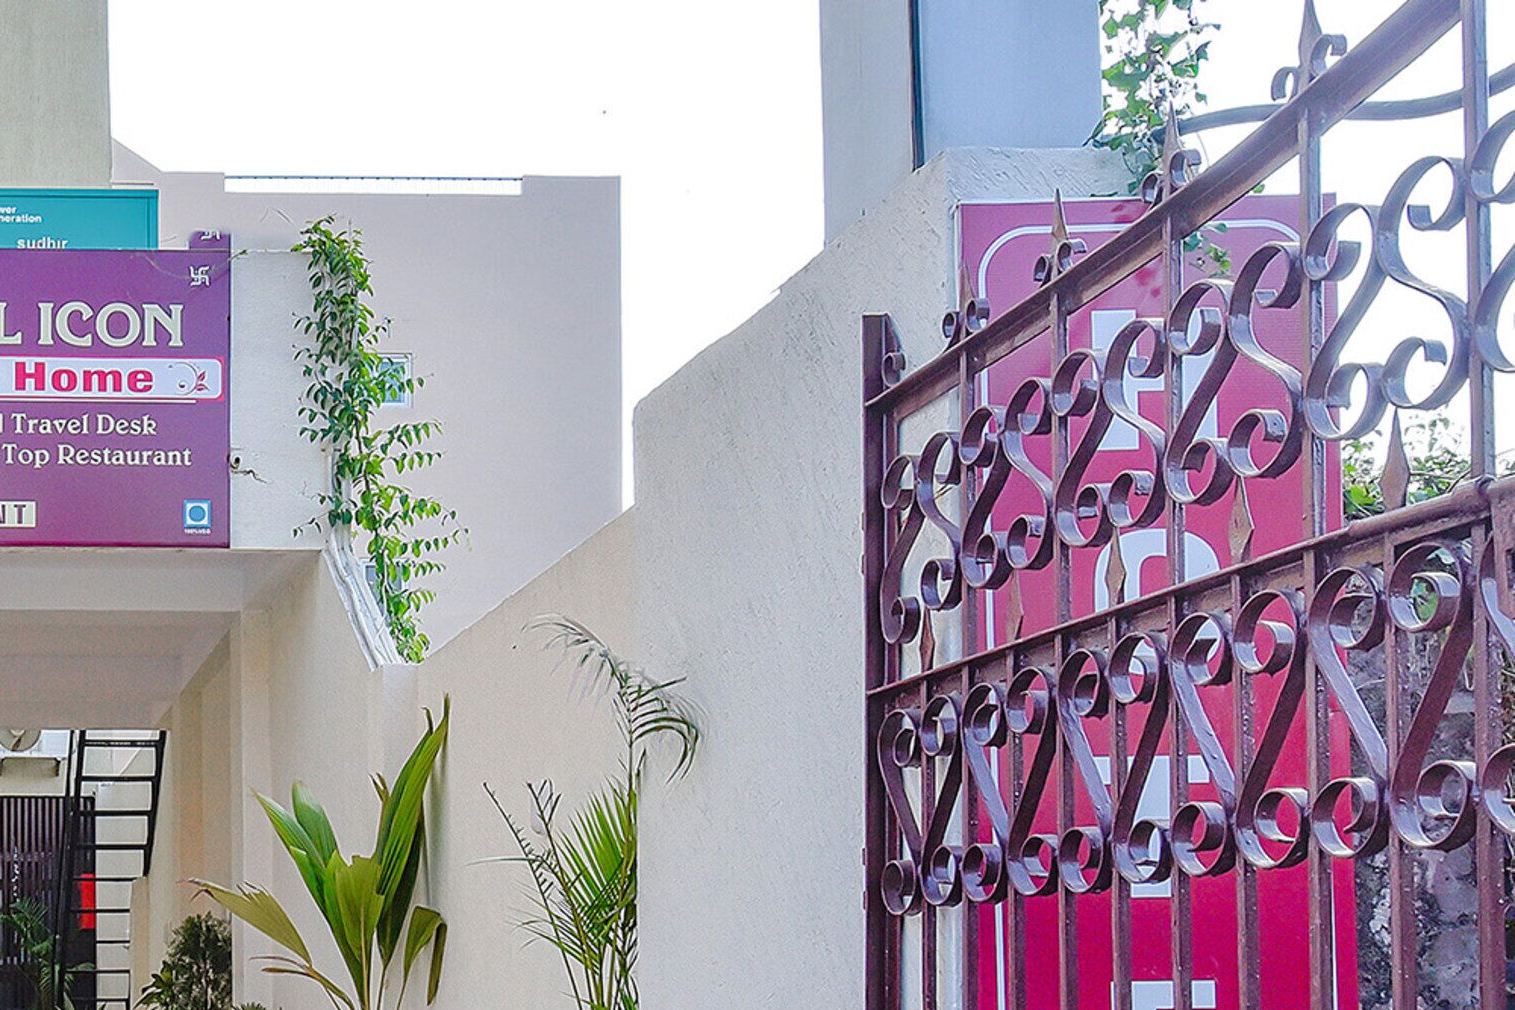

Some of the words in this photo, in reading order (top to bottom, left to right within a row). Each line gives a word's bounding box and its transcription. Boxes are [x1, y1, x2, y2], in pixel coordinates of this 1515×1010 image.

[17, 237, 68, 249] sudhir
[37, 301, 184, 347] ICON
[14, 362, 154, 393] Home
[11, 413, 89, 435] Travel
[96, 414, 157, 436] Desk
[1, 444, 50, 469] Top
[57, 445, 192, 466] Restaurant
